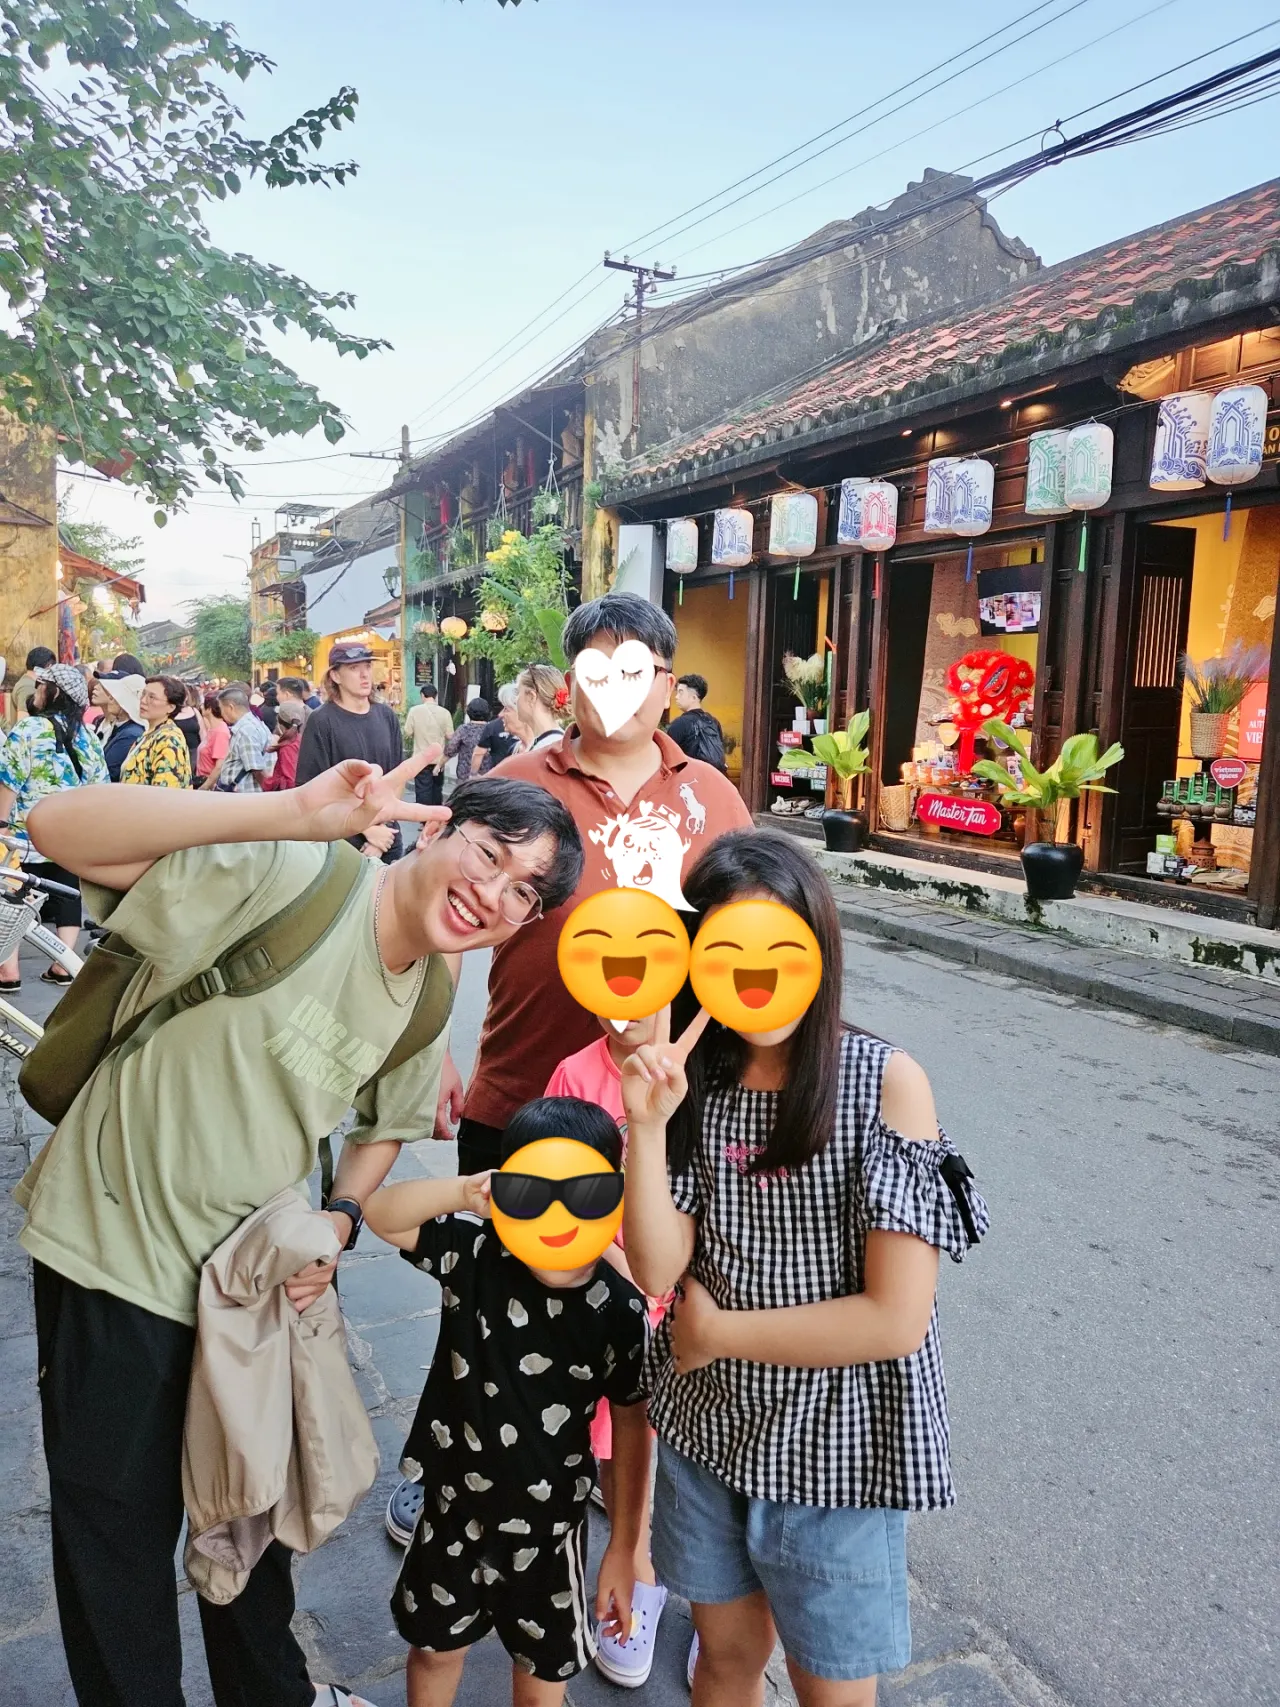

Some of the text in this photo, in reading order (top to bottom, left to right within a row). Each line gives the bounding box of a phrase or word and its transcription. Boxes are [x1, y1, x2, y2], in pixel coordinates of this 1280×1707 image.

[928, 799, 987, 826] Master Tan
[287, 994, 348, 1052] LIVNG
